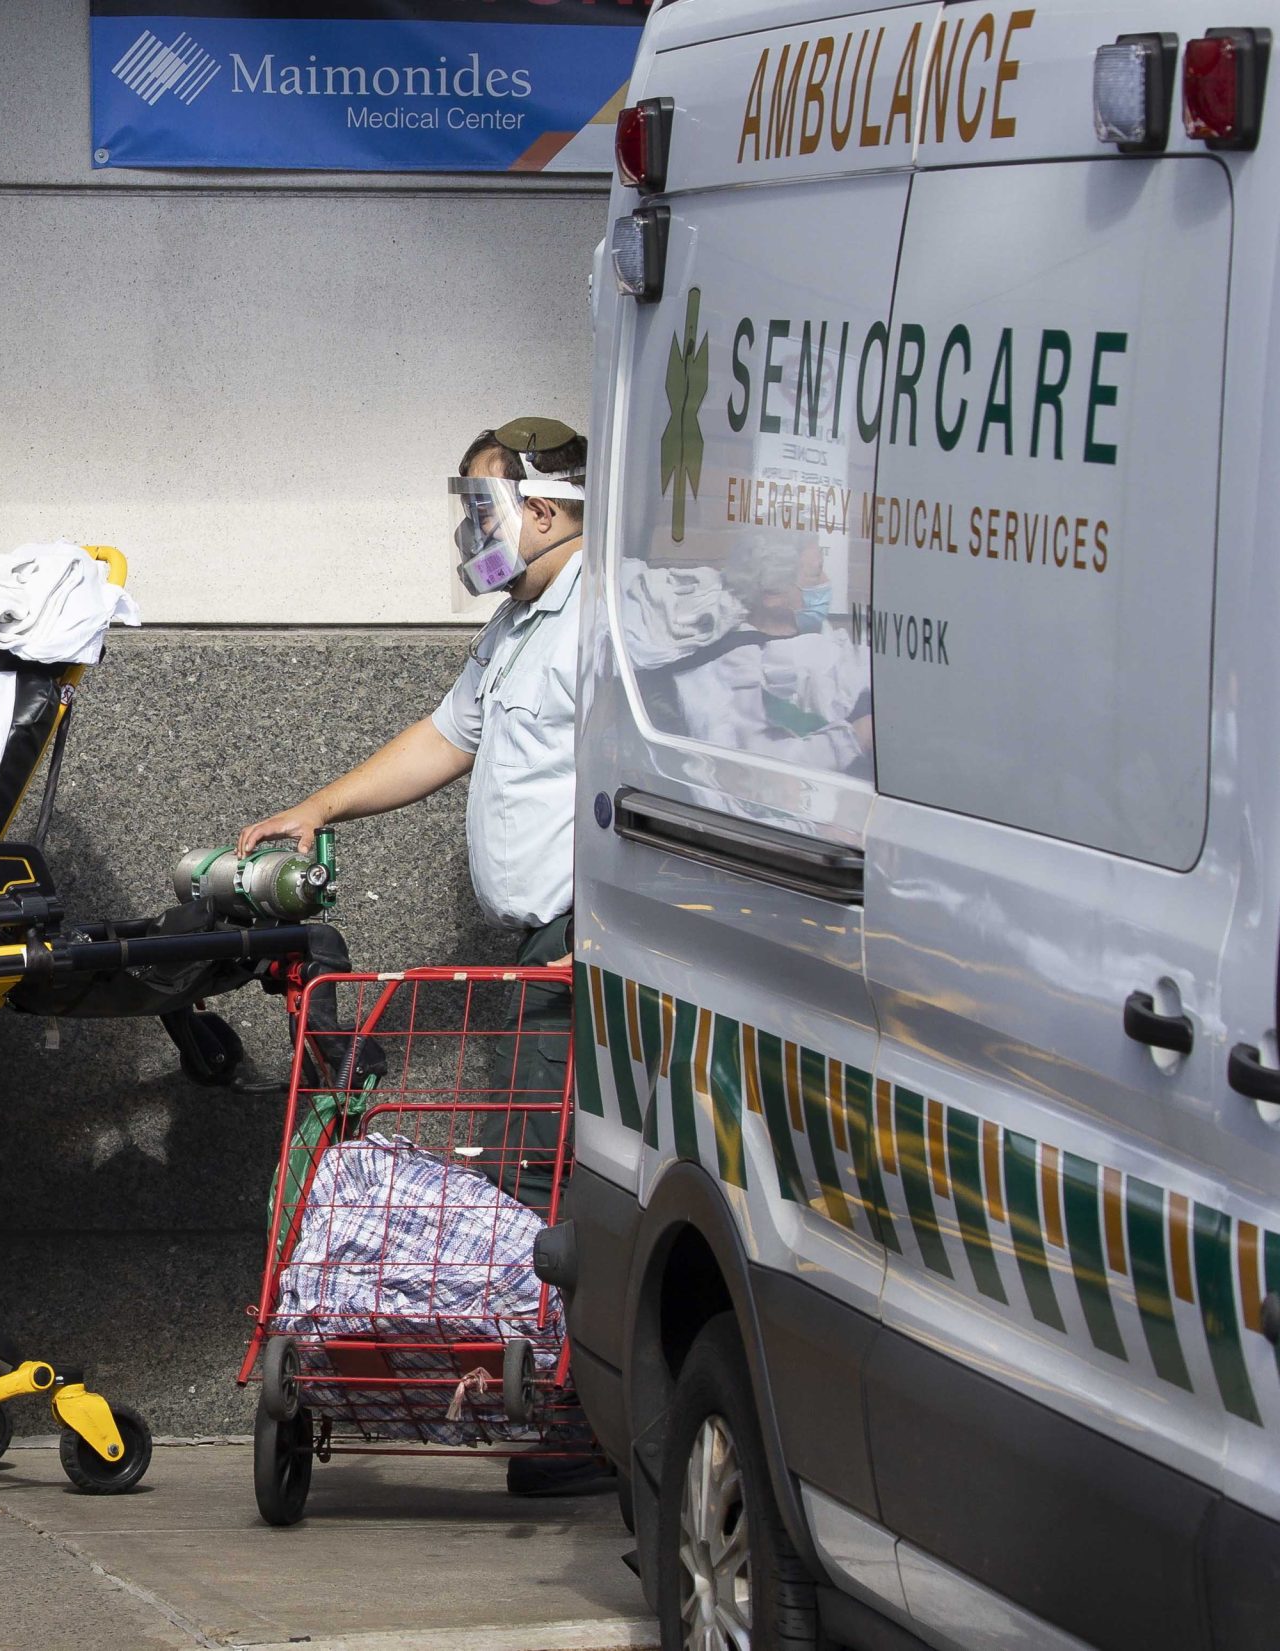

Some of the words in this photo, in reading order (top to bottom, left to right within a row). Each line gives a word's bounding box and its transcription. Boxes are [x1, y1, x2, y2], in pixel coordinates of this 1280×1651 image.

[229, 52, 533, 98] Maimonides
[736, 9, 1035, 164] AMBULANCE
[347, 107, 439, 129] Medical
[447, 107, 526, 130] Center
[727, 316, 1128, 465] SENIORCARE
[726, 477, 851, 532] EMERGENCY
[861, 490, 959, 554] MEDICAL
[969, 505, 1109, 573] SERVICES
[852, 602, 888, 655] NEW
[893, 613, 949, 665] YORK
